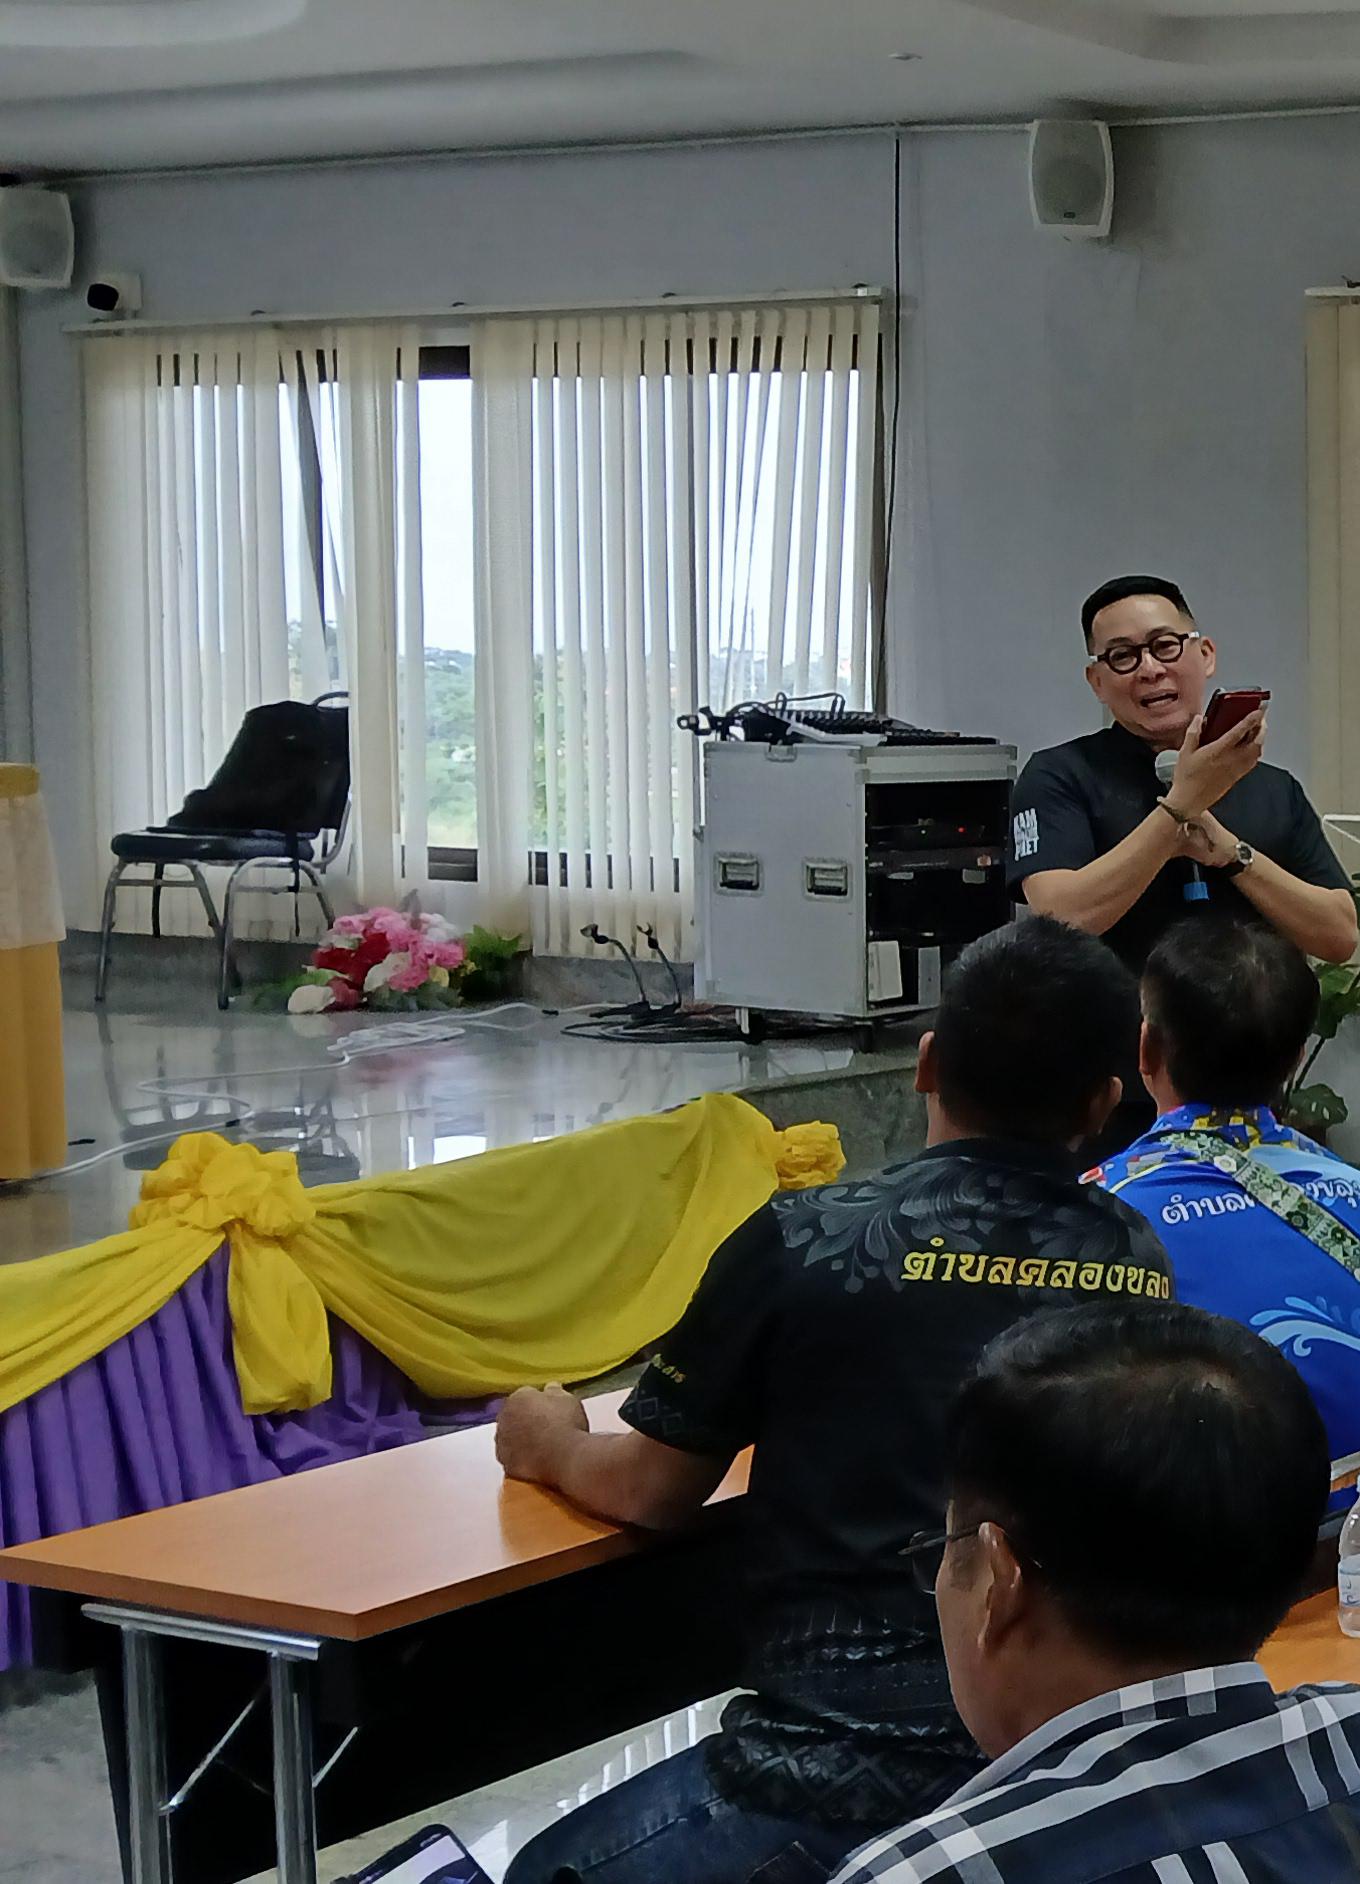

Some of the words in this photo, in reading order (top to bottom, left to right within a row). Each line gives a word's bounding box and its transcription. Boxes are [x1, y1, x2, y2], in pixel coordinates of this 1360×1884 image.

[900, 1236, 1170, 1300] ตำบลคลองขลง
